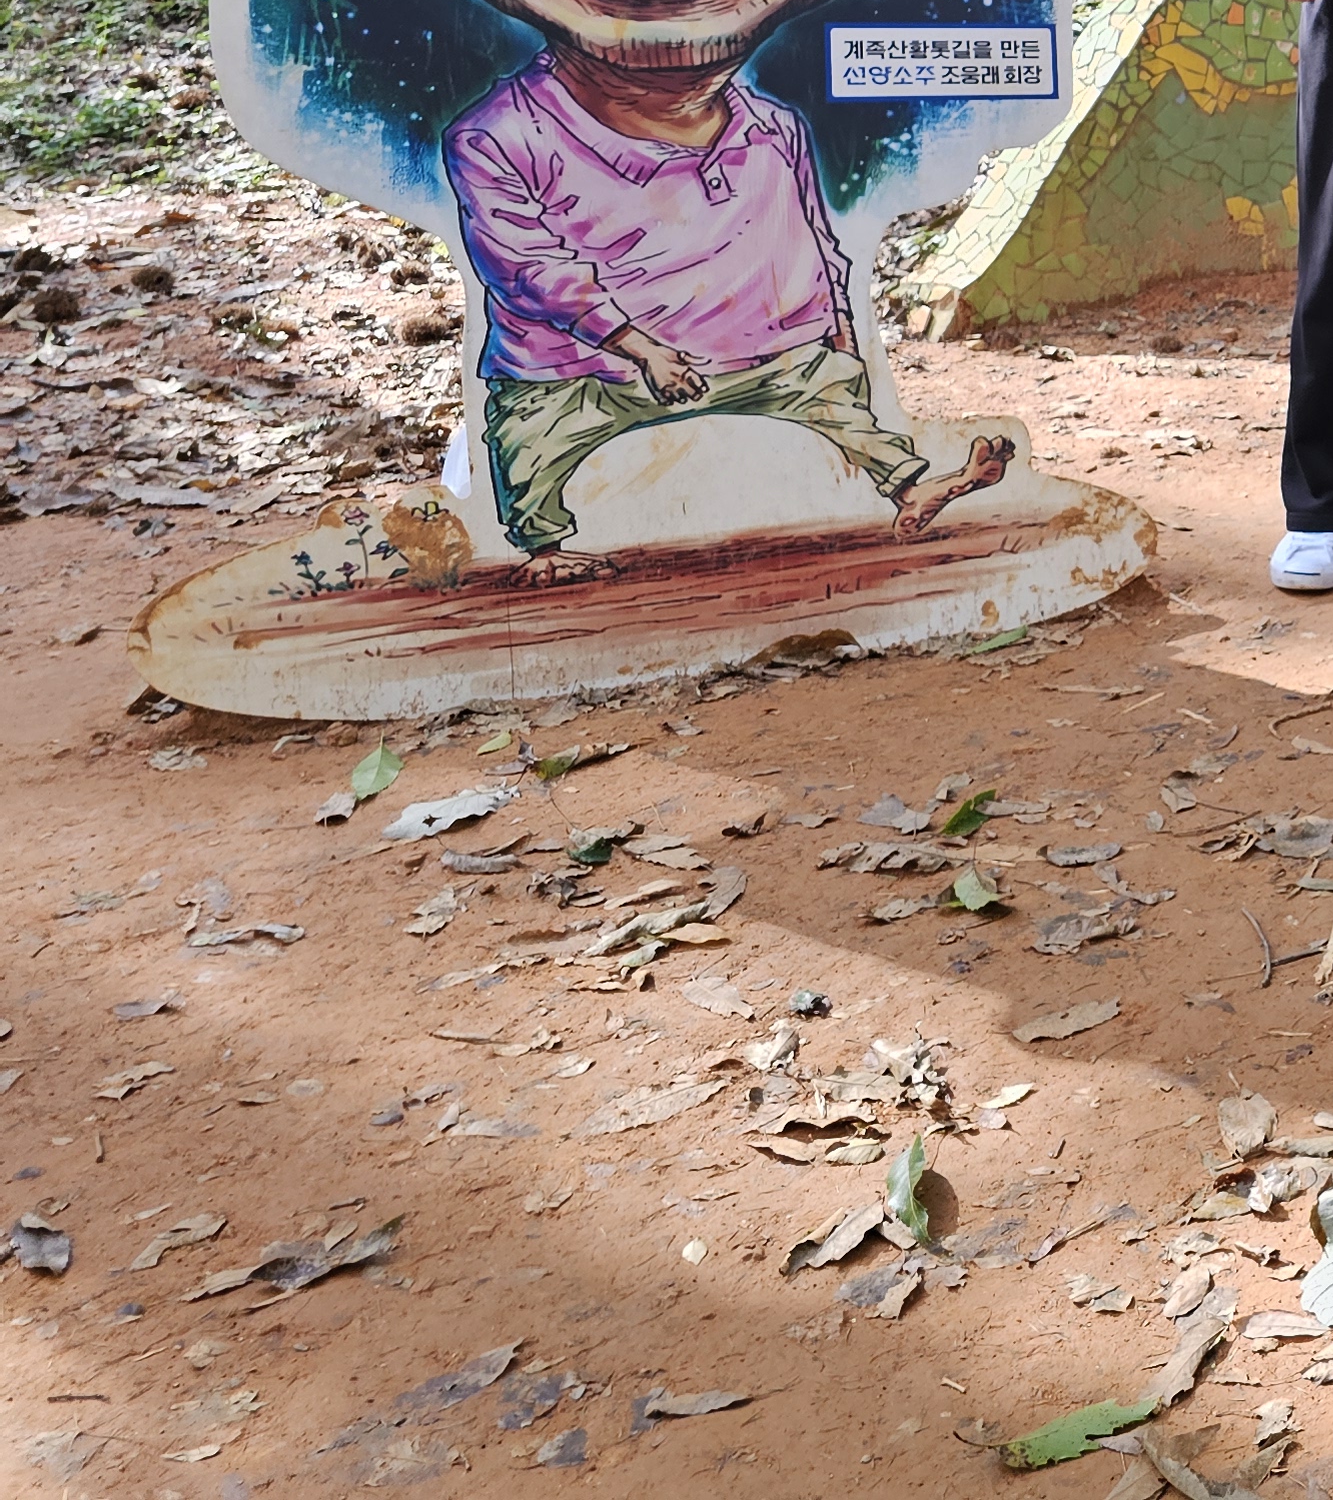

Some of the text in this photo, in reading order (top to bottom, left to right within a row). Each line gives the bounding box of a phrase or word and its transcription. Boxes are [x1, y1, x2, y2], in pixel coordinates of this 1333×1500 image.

[843, 39, 1041, 60] 계족산황톳길을 만든
[842, 64, 1043, 86] 선양소주 조웅래 회장
